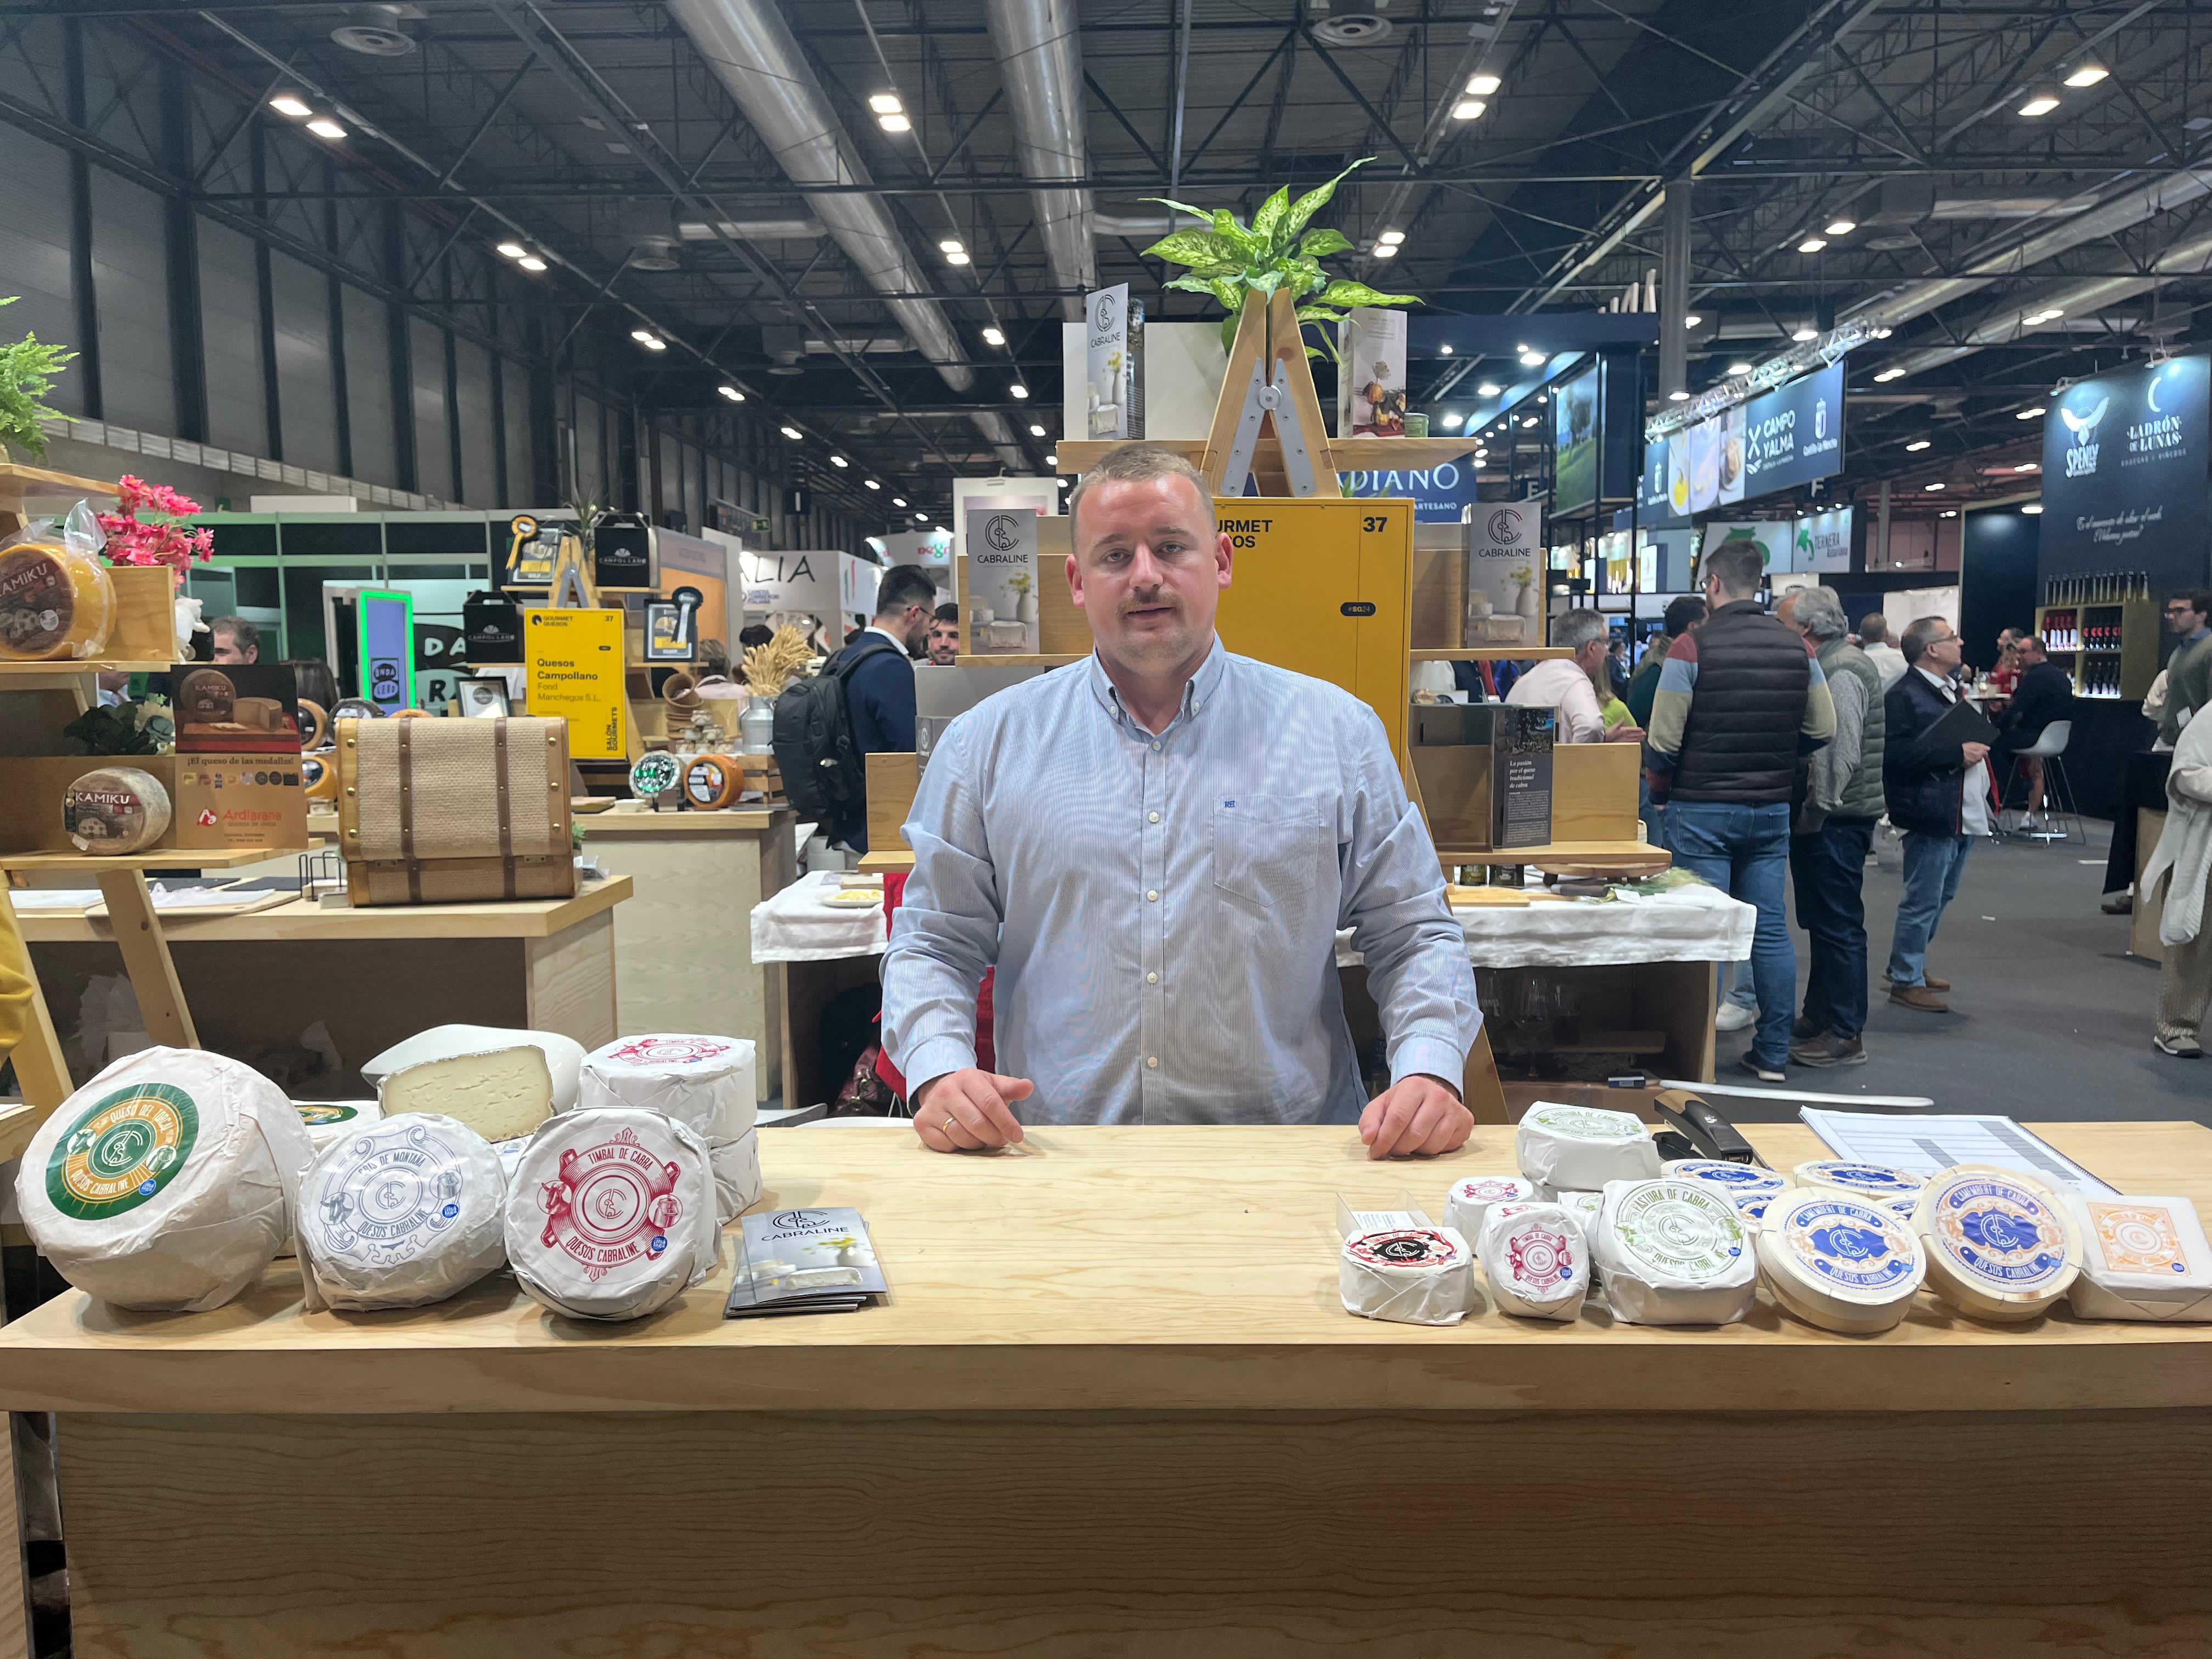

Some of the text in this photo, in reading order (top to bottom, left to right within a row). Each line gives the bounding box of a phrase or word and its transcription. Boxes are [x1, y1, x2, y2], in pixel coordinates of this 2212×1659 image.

[1091, 332, 1120, 348] CABRALINE
[1763, 410, 1796, 438] CAMPO
[2129, 414, 2182, 439] LADRÓN
[2140, 431, 2182, 452] LUNAS
[1811, 477, 1825, 498] F
[1363, 517, 1387, 532] 37
[978, 555, 1028, 563] CABRALINE
[1479, 549, 1531, 557] CABRALINE
[0, 563, 47, 596] AMIKU
[537, 658, 574, 667] Quesos
[537, 671, 598, 681] Campollano
[538, 693, 583, 703] Manchegos
[201, 757, 227, 766] queso
[229, 757, 239, 765] de
[241, 757, 253, 765] las
[255, 757, 294, 765] medallas!
[75, 792, 130, 805] KAMIKU
[110, 1105, 137, 1123] QUESO
[138, 1104, 154, 1117] DEL
[379, 1154, 389, 1166] DE
[393, 1152, 426, 1167] MONTAÑA
[588, 1148, 653, 1171] TIMBAL DE CABRA
[70, 1169, 130, 1195] QUESOS CABRALINE
[1667, 1189, 1677, 1200] DE
[1682, 1191, 1710, 1211] CABRA
[1954, 1184, 2029, 1207] CAMEMBERT DE CABRA
[358, 1220, 387, 1238] QUESOS
[390, 1207, 430, 1235] CABRALINE
[1838, 1206, 1847, 1215] DE
[1849, 1208, 1872, 1222] CABRA
[761, 1227, 849, 1242] CABRALINE
[566, 1236, 640, 1262] QUESOS CABRALINE
[1830, 1267, 1897, 1284] QUESOS CABRALINE
[1974, 1257, 2043, 1279] QUESOS CABRALINE
